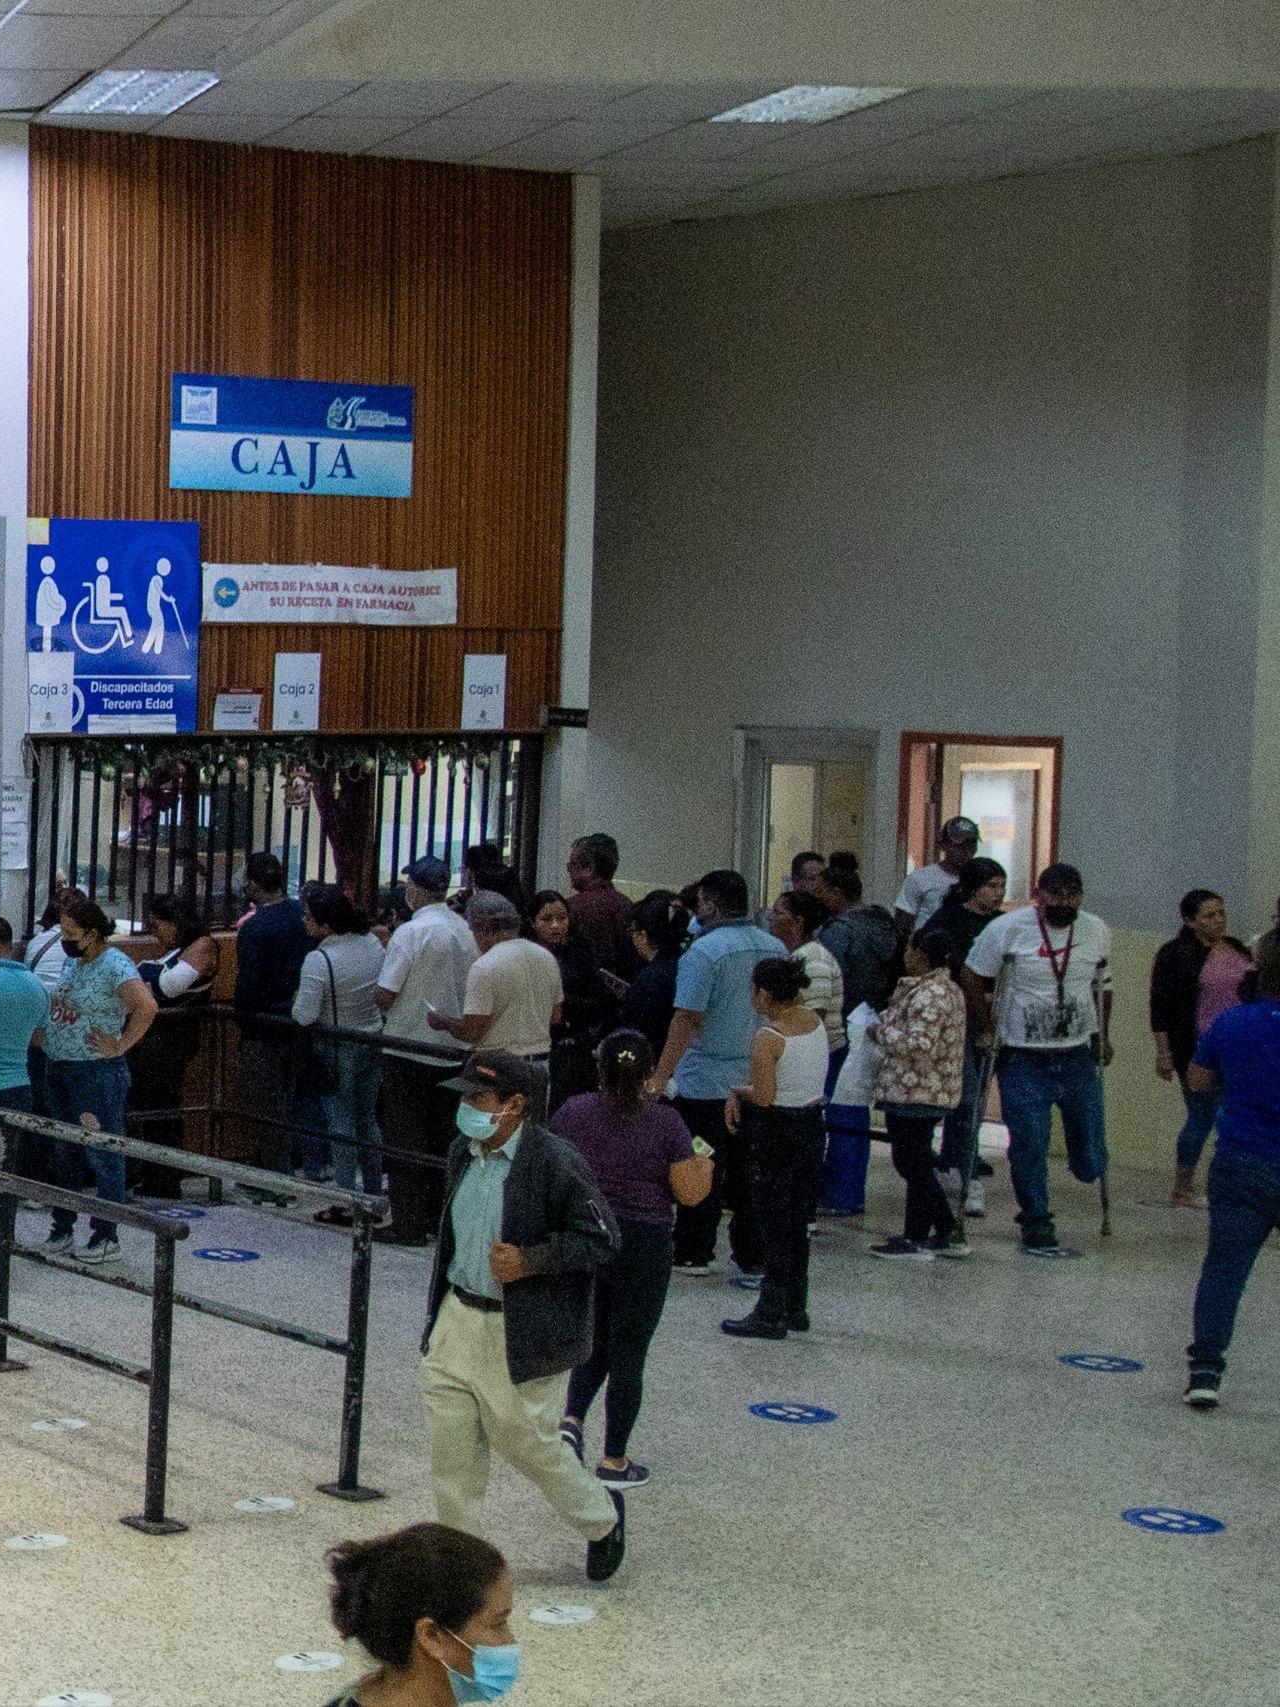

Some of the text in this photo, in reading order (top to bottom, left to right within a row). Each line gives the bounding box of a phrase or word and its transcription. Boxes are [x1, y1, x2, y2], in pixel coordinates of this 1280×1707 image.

[230, 437, 357, 491] CAJA
[242, 580, 280, 592] ANTES
[281, 581, 296, 592] DE
[298, 581, 339, 593] PASAR
[342, 584, 350, 592] A
[353, 583, 385, 595] CAJA
[269, 596, 416, 612] SU RECETA EN FARMACIA
[30, 683, 69, 699] Caja 3
[90, 681, 174, 695] Discapacitados
[278, 683, 315, 698] Caja 2
[468, 684, 500, 698] Caja 1
[102, 698, 174, 710] Tercera Edad
